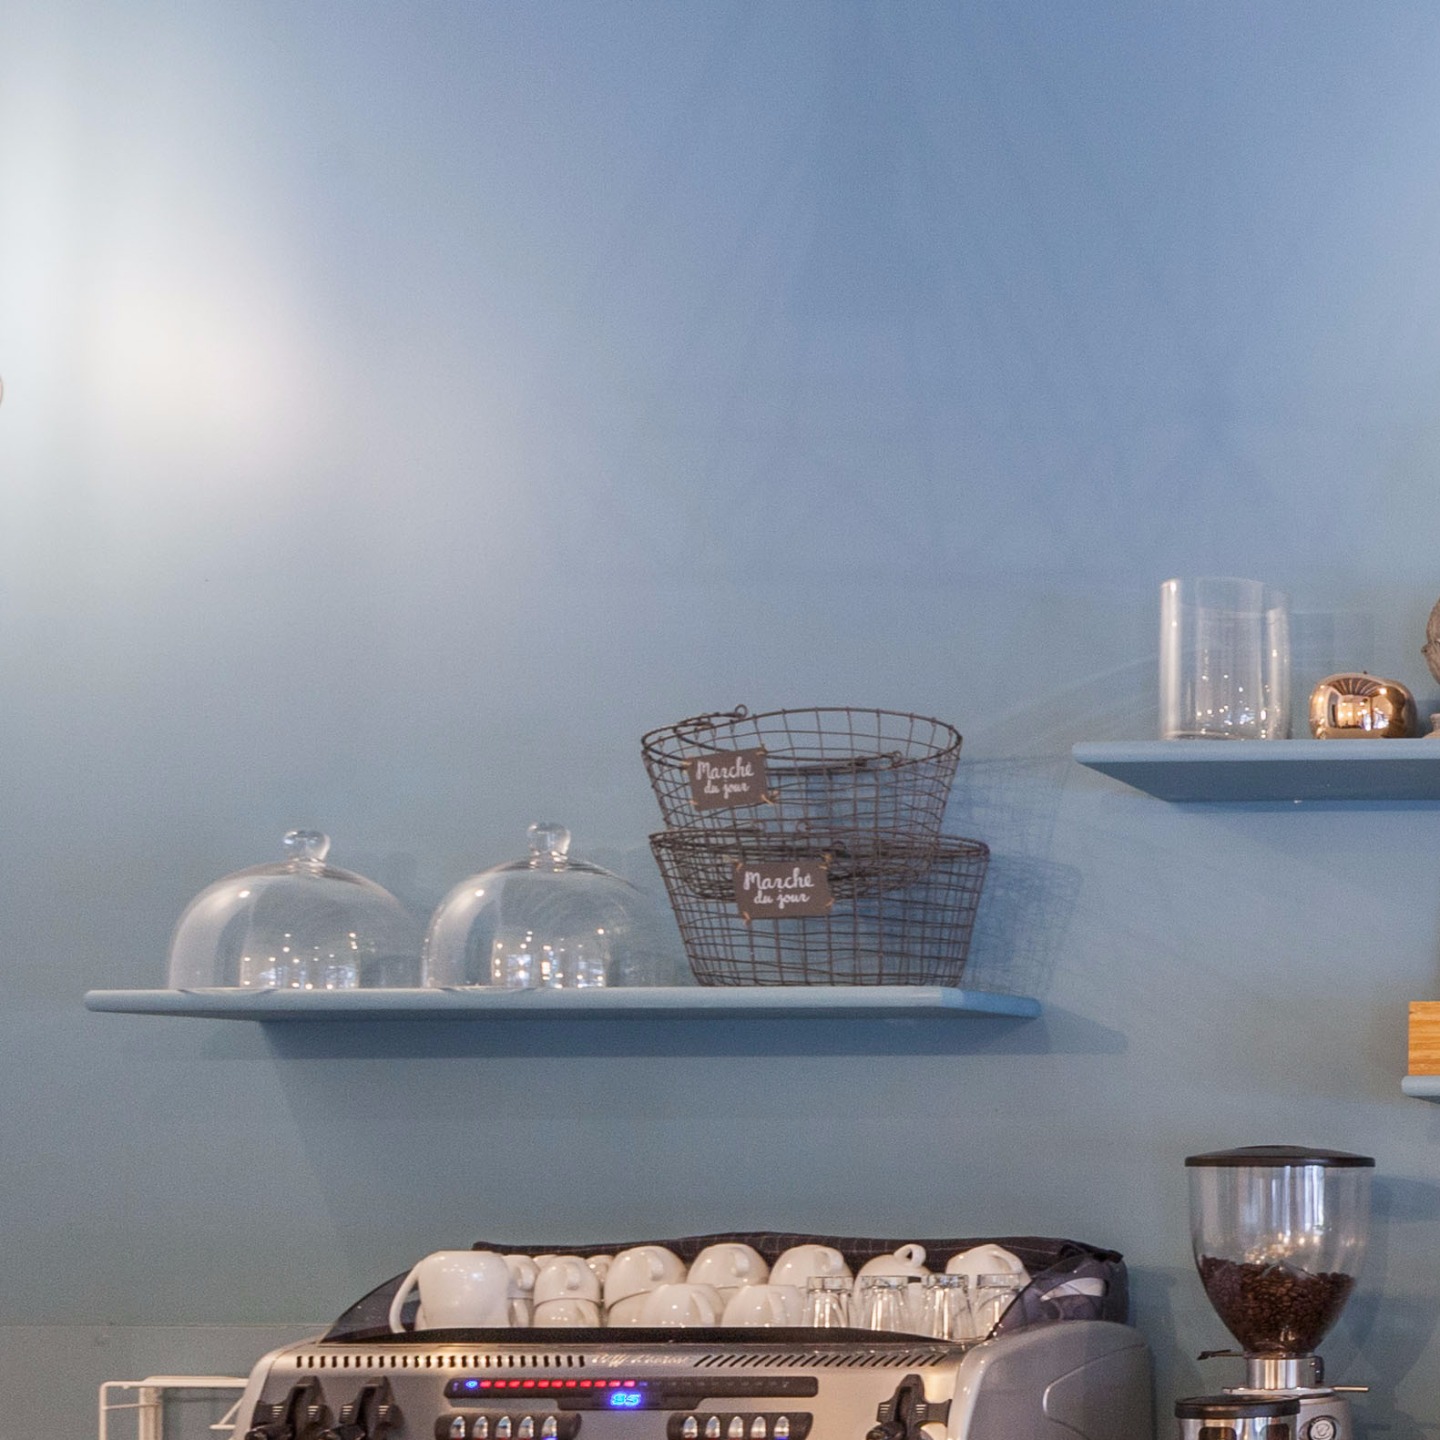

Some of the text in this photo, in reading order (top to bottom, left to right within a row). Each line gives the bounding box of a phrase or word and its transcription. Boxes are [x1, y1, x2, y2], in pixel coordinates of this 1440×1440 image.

[704, 780, 751, 799] du jour
[754, 889, 811, 910] du jour
